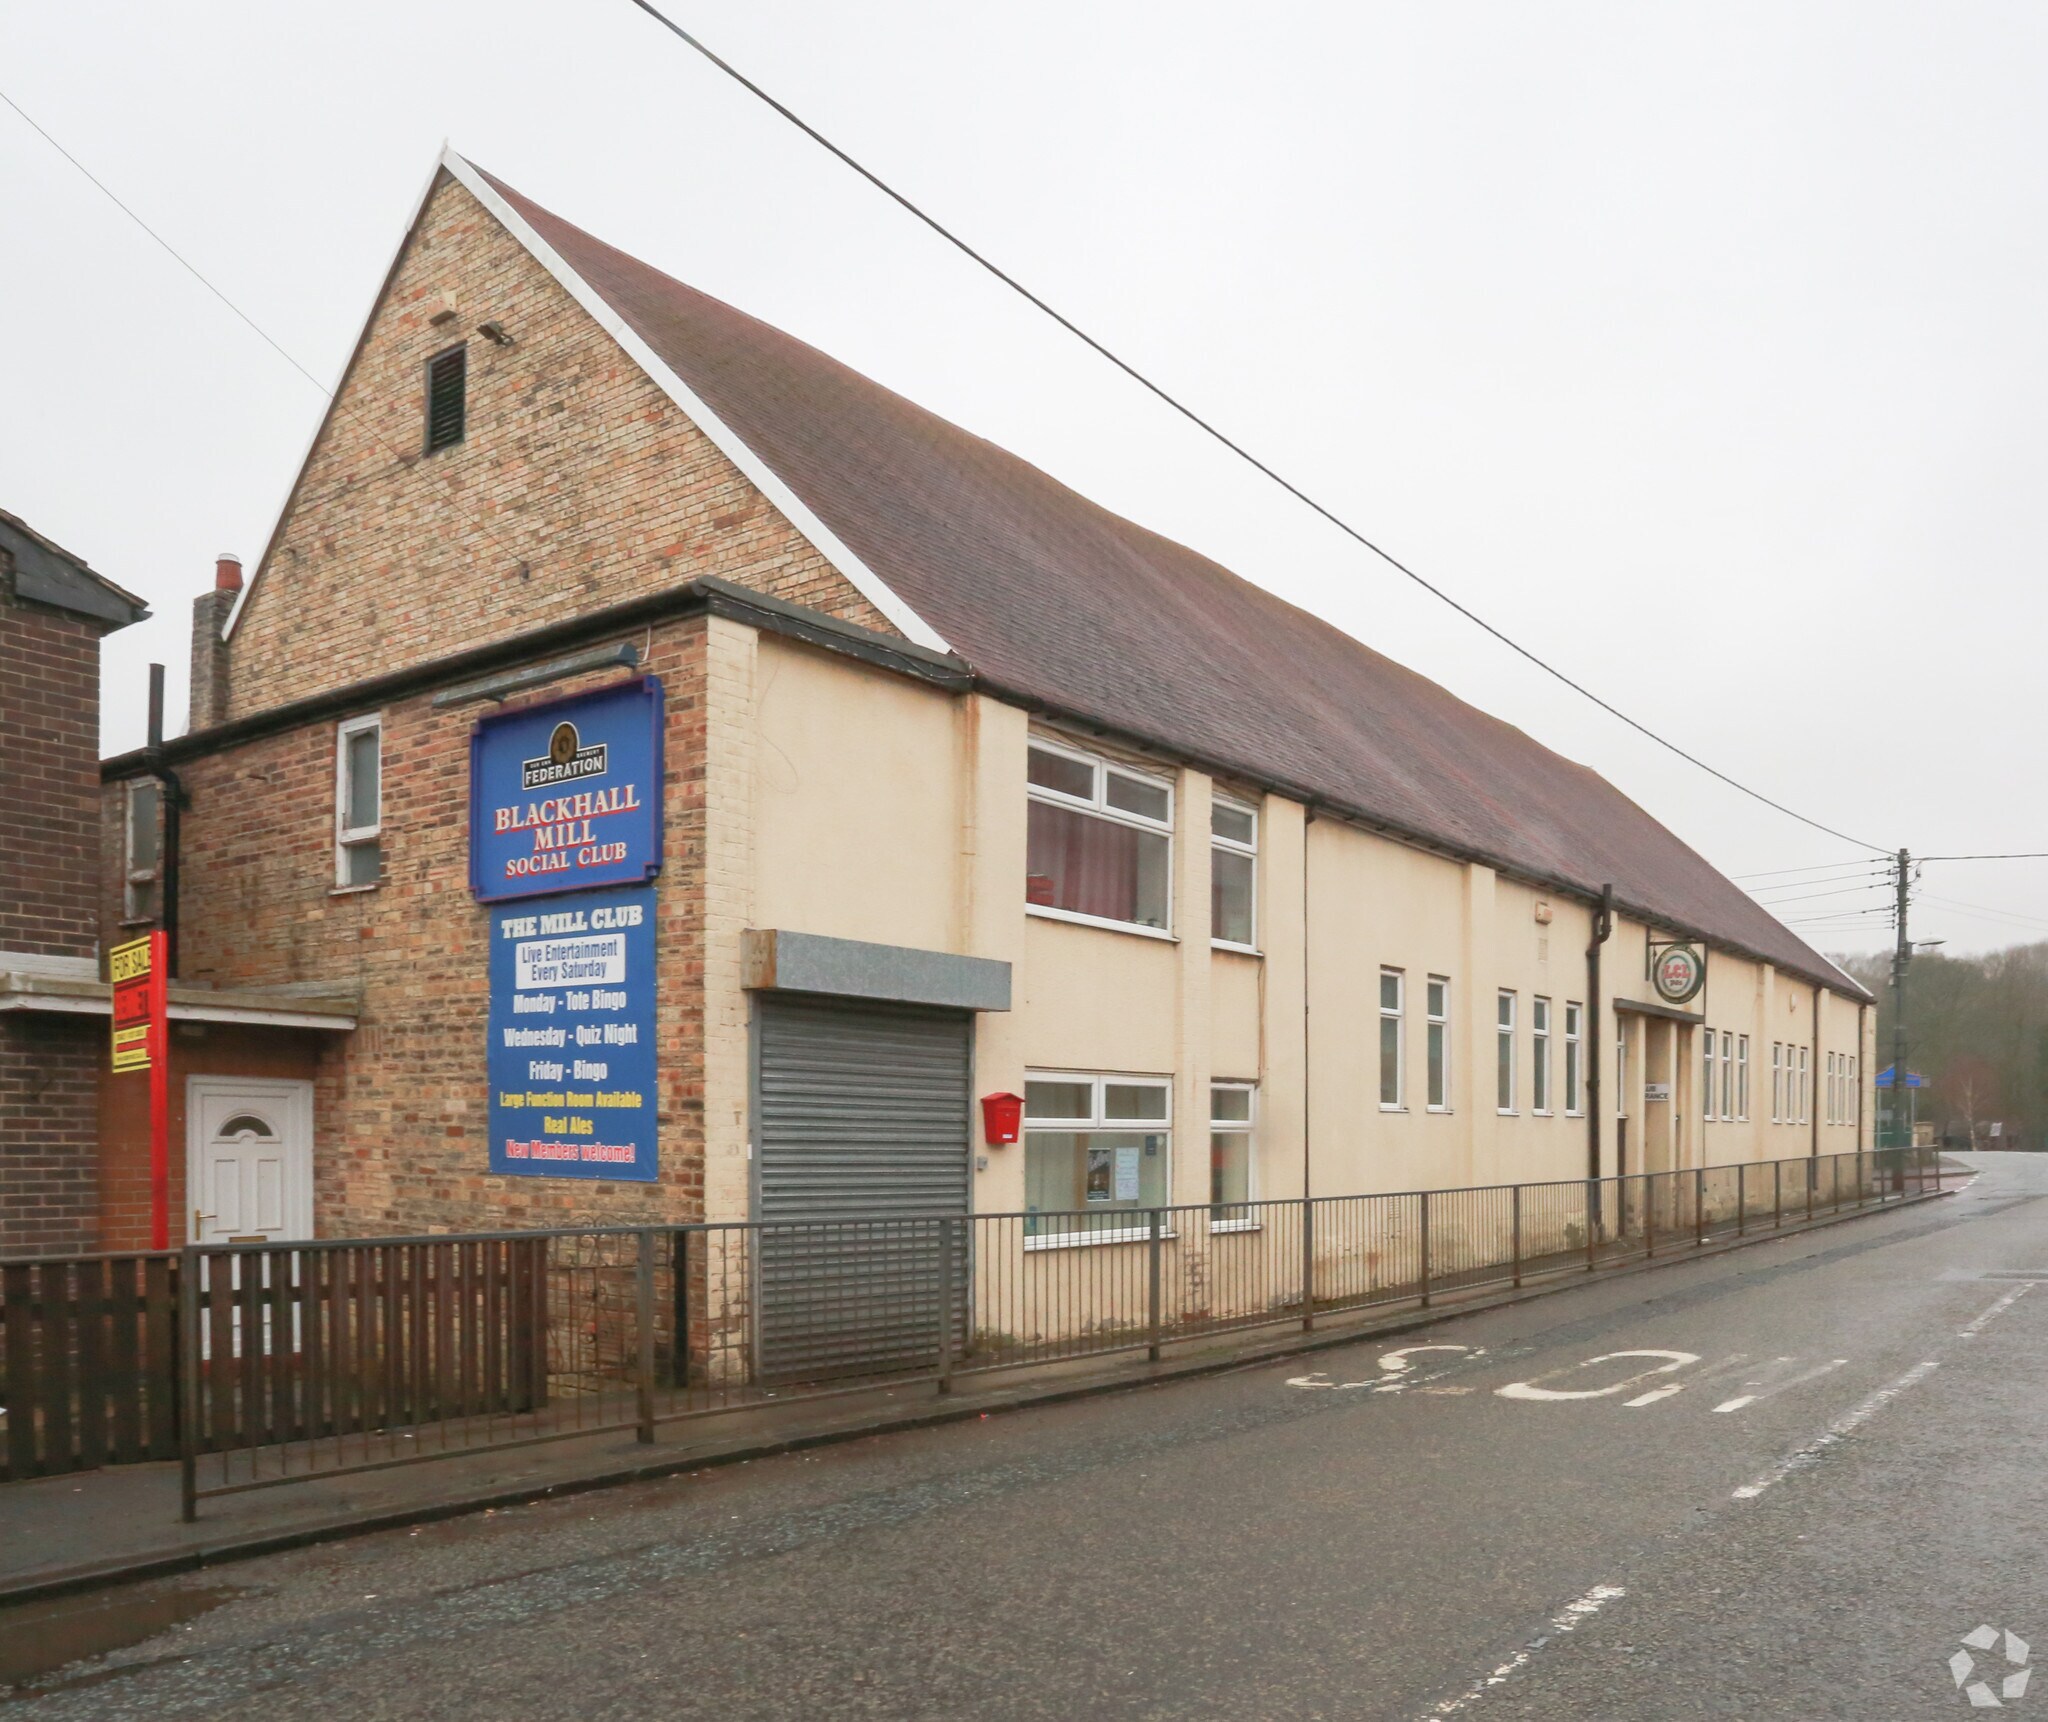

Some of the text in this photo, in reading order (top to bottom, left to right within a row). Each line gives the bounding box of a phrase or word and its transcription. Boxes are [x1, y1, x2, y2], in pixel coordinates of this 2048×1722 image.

[525, 755, 603, 786] FEDERATION
[495, 784, 640, 832] BLACKHALL
[534, 820, 596, 851] MILL
[506, 841, 627, 877] SOCIAL CLUB
[501, 905, 643, 939] THE MILL CLUB
[522, 939, 617, 963] Live Entertainment
[113, 953, 130, 979] FOR
[531, 961, 607, 982] Every Saturday
[513, 994, 555, 1014] Monday
[566, 991, 589, 1010] Tote
[592, 989, 626, 1011] Bingo
[504, 1028, 566, 1047] Wednesday
[576, 1025, 601, 1046] Quiz
[604, 1023, 637, 1046] Night
[529, 1060, 563, 1082] Friday
[573, 1059, 608, 1081] Bingo
[500, 1091, 642, 1108] Large Function Room Available
[544, 1116, 593, 1135] Real Ales
[506, 1139, 636, 1163] New Members welcome!
